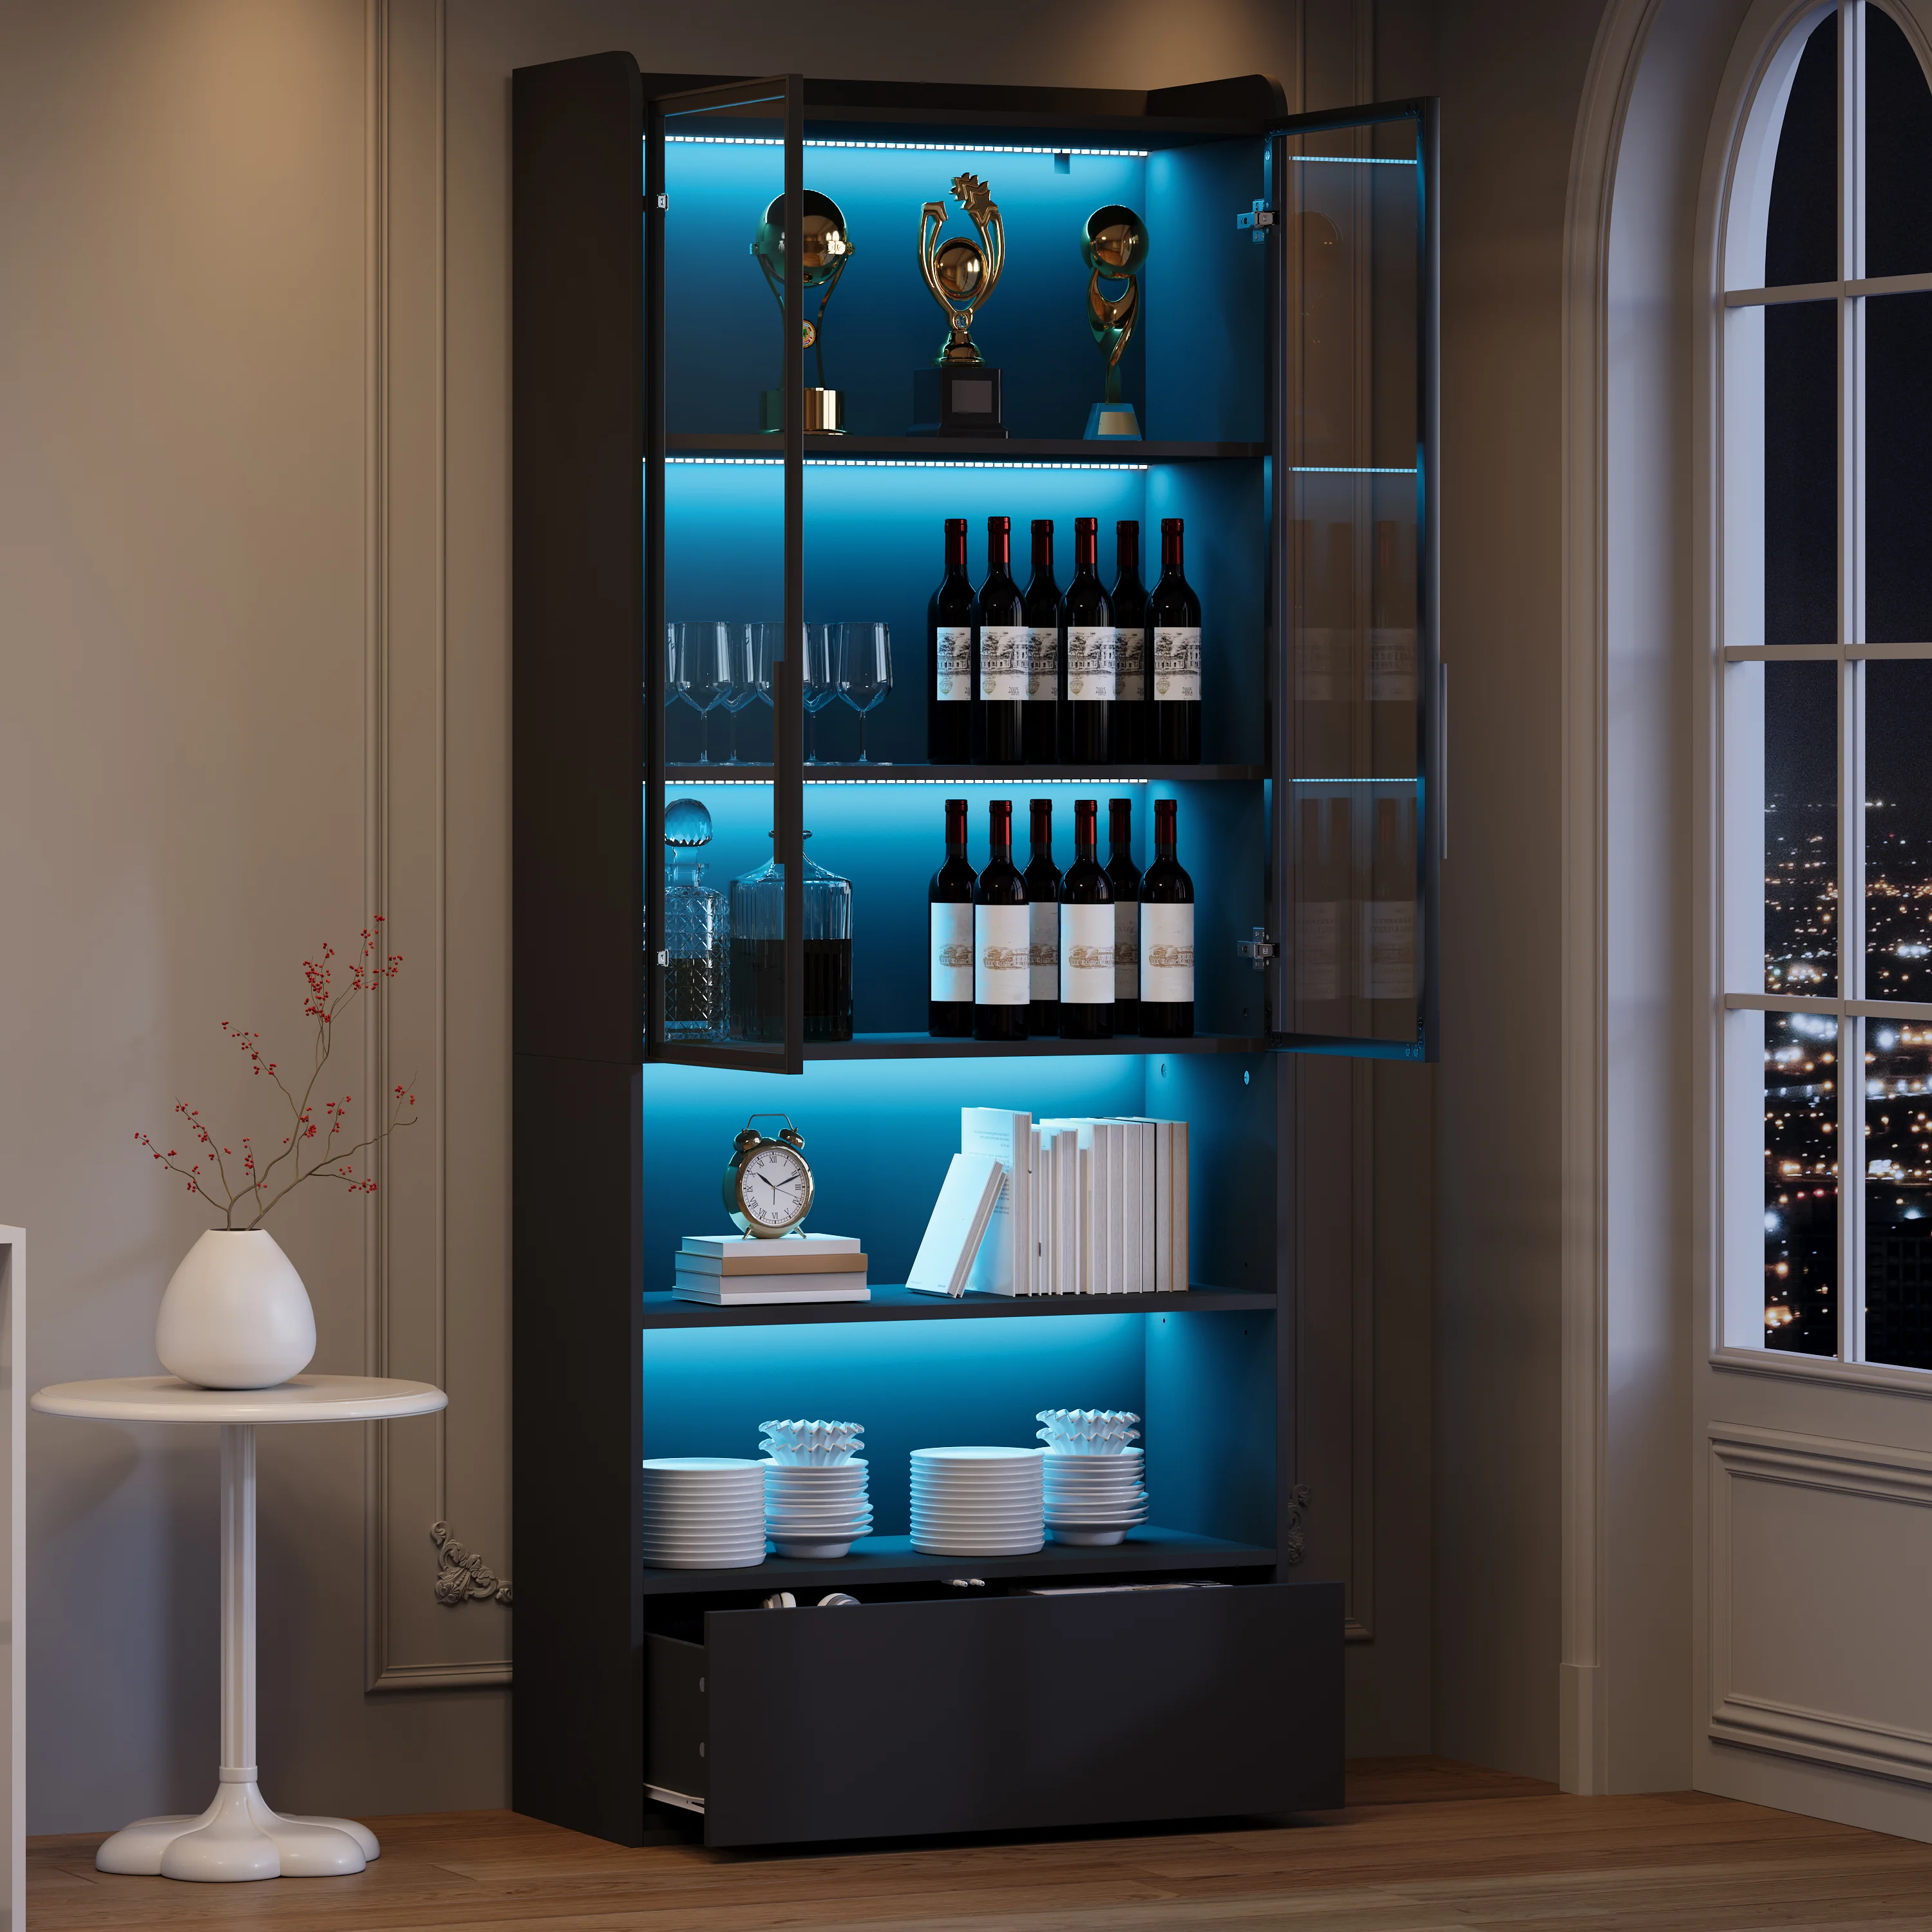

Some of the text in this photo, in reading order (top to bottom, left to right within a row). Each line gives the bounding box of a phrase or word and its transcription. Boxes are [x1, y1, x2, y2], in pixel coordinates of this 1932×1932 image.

[1182, 687, 1193, 695] 2005
[757, 1160, 764, 1168] XI
[750, 1197, 758, 1208] VIII
[792, 1197, 799, 1205] IV
